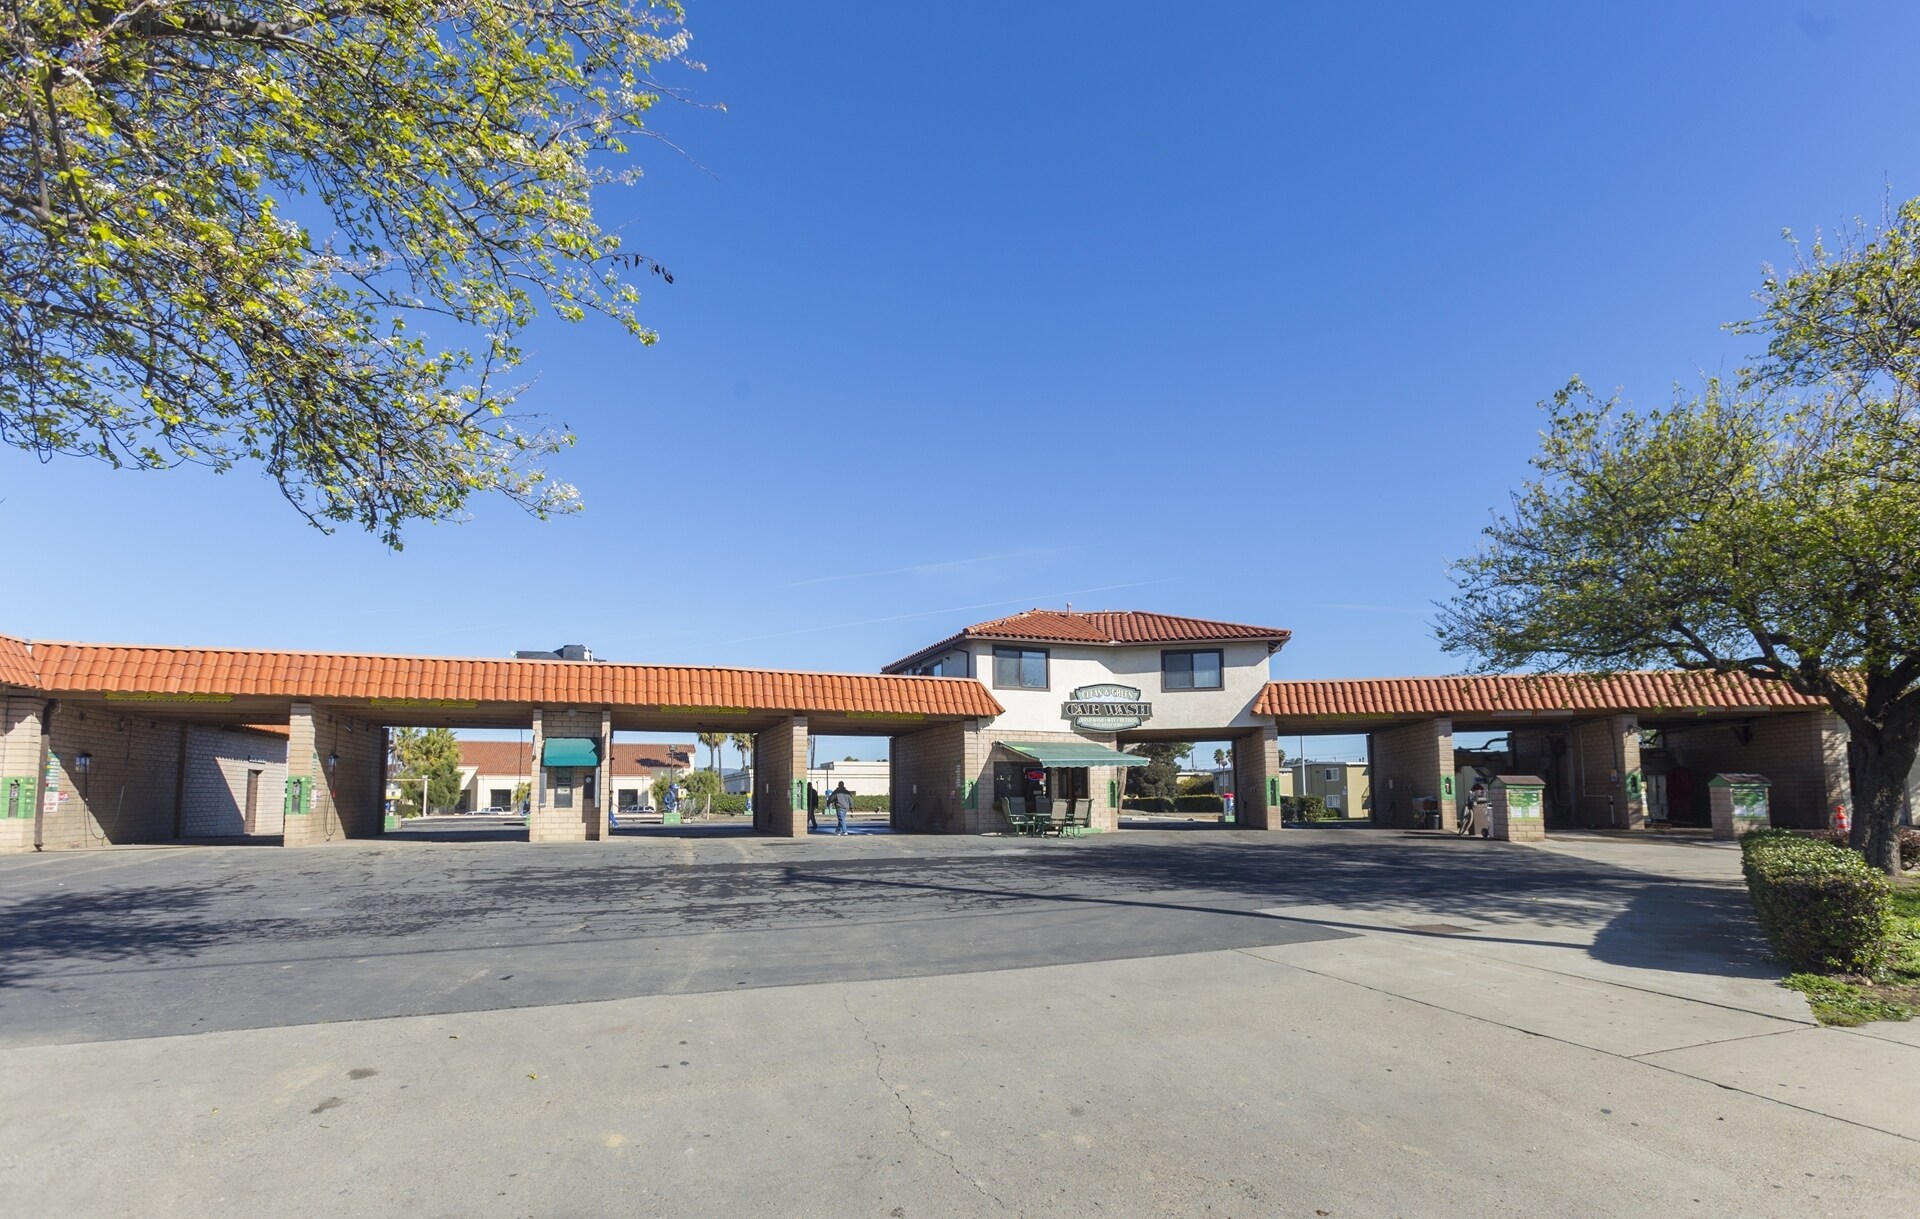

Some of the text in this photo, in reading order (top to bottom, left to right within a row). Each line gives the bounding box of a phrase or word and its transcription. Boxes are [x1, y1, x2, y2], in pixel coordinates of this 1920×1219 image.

[1082, 689, 1102, 698] CLEAN
[1111, 688, 1133, 698] GREEN
[1067, 704, 1150, 716] CAR WASH
